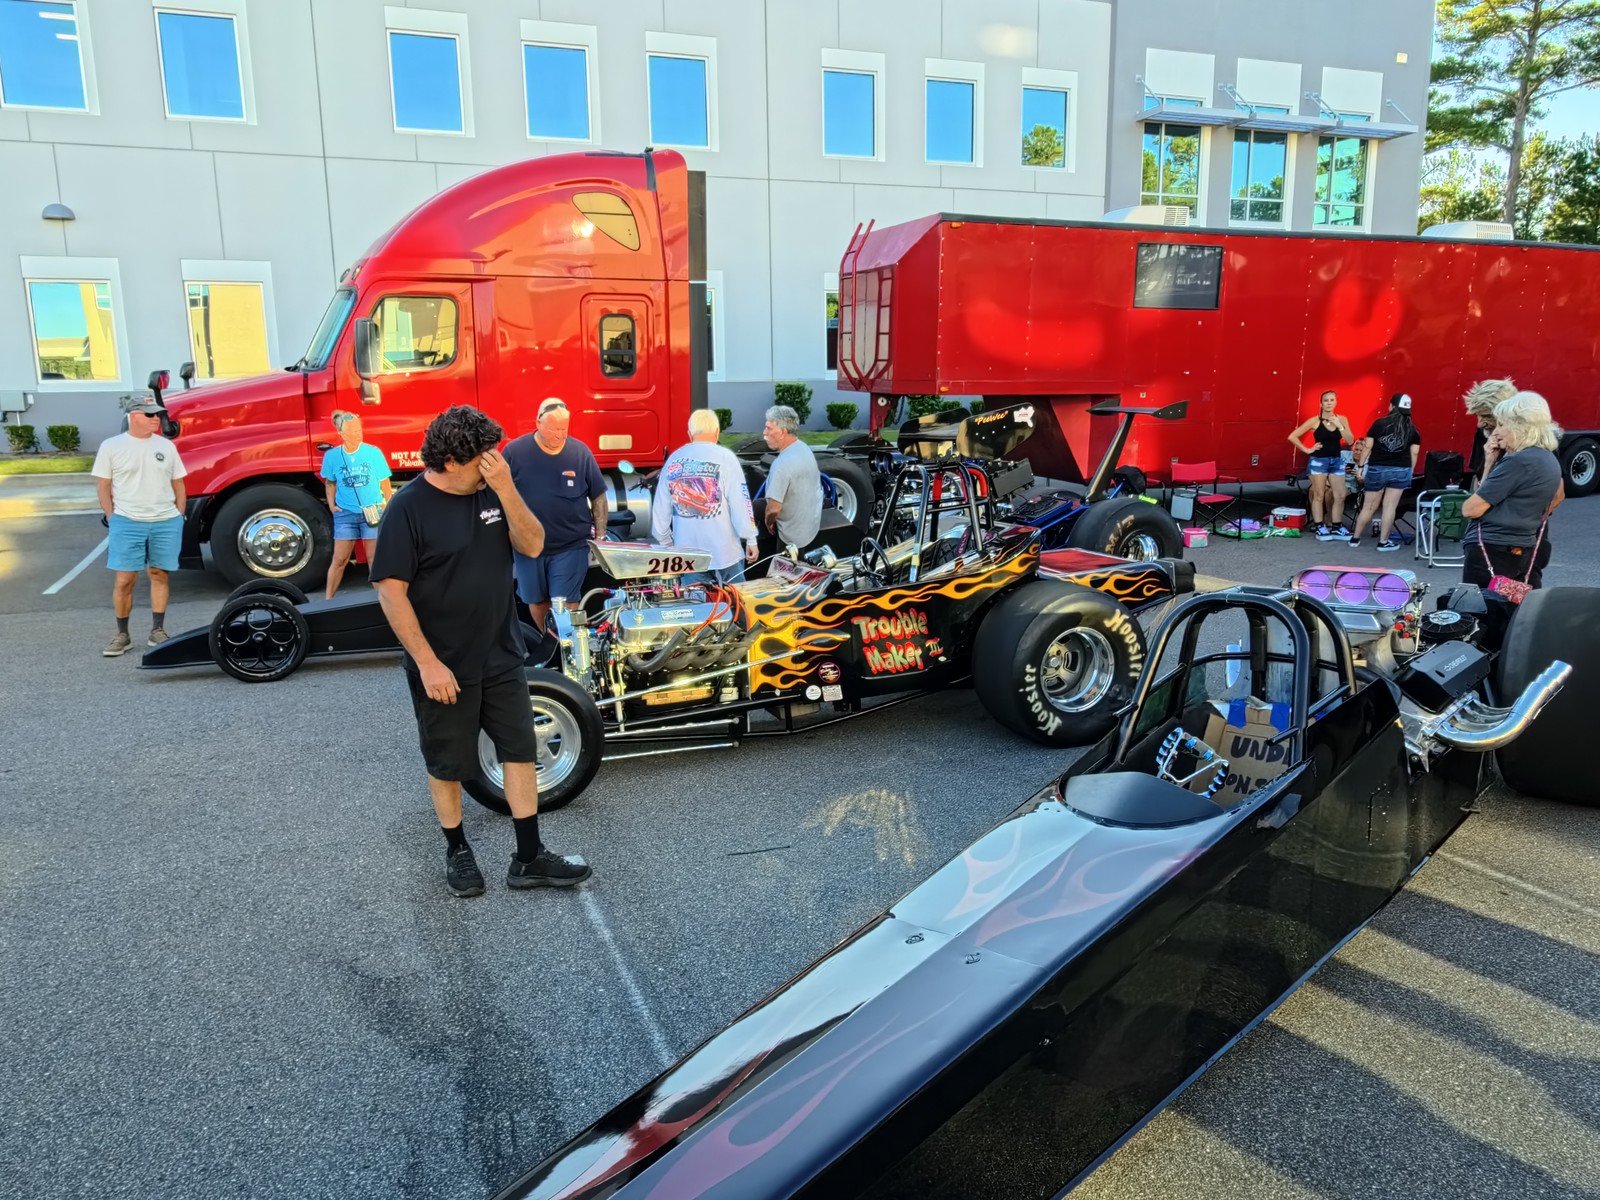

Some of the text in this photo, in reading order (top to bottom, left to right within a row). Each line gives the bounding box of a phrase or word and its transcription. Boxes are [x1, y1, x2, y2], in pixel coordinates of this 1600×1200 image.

[391, 451, 409, 460] NOT
[647, 556, 696, 575] 218x
[851, 608, 928, 643] Trouble
[863, 641, 924, 675] Maker
[1103, 608, 1146, 680] Hoosier
[1018, 663, 1063, 736] Hoosier
